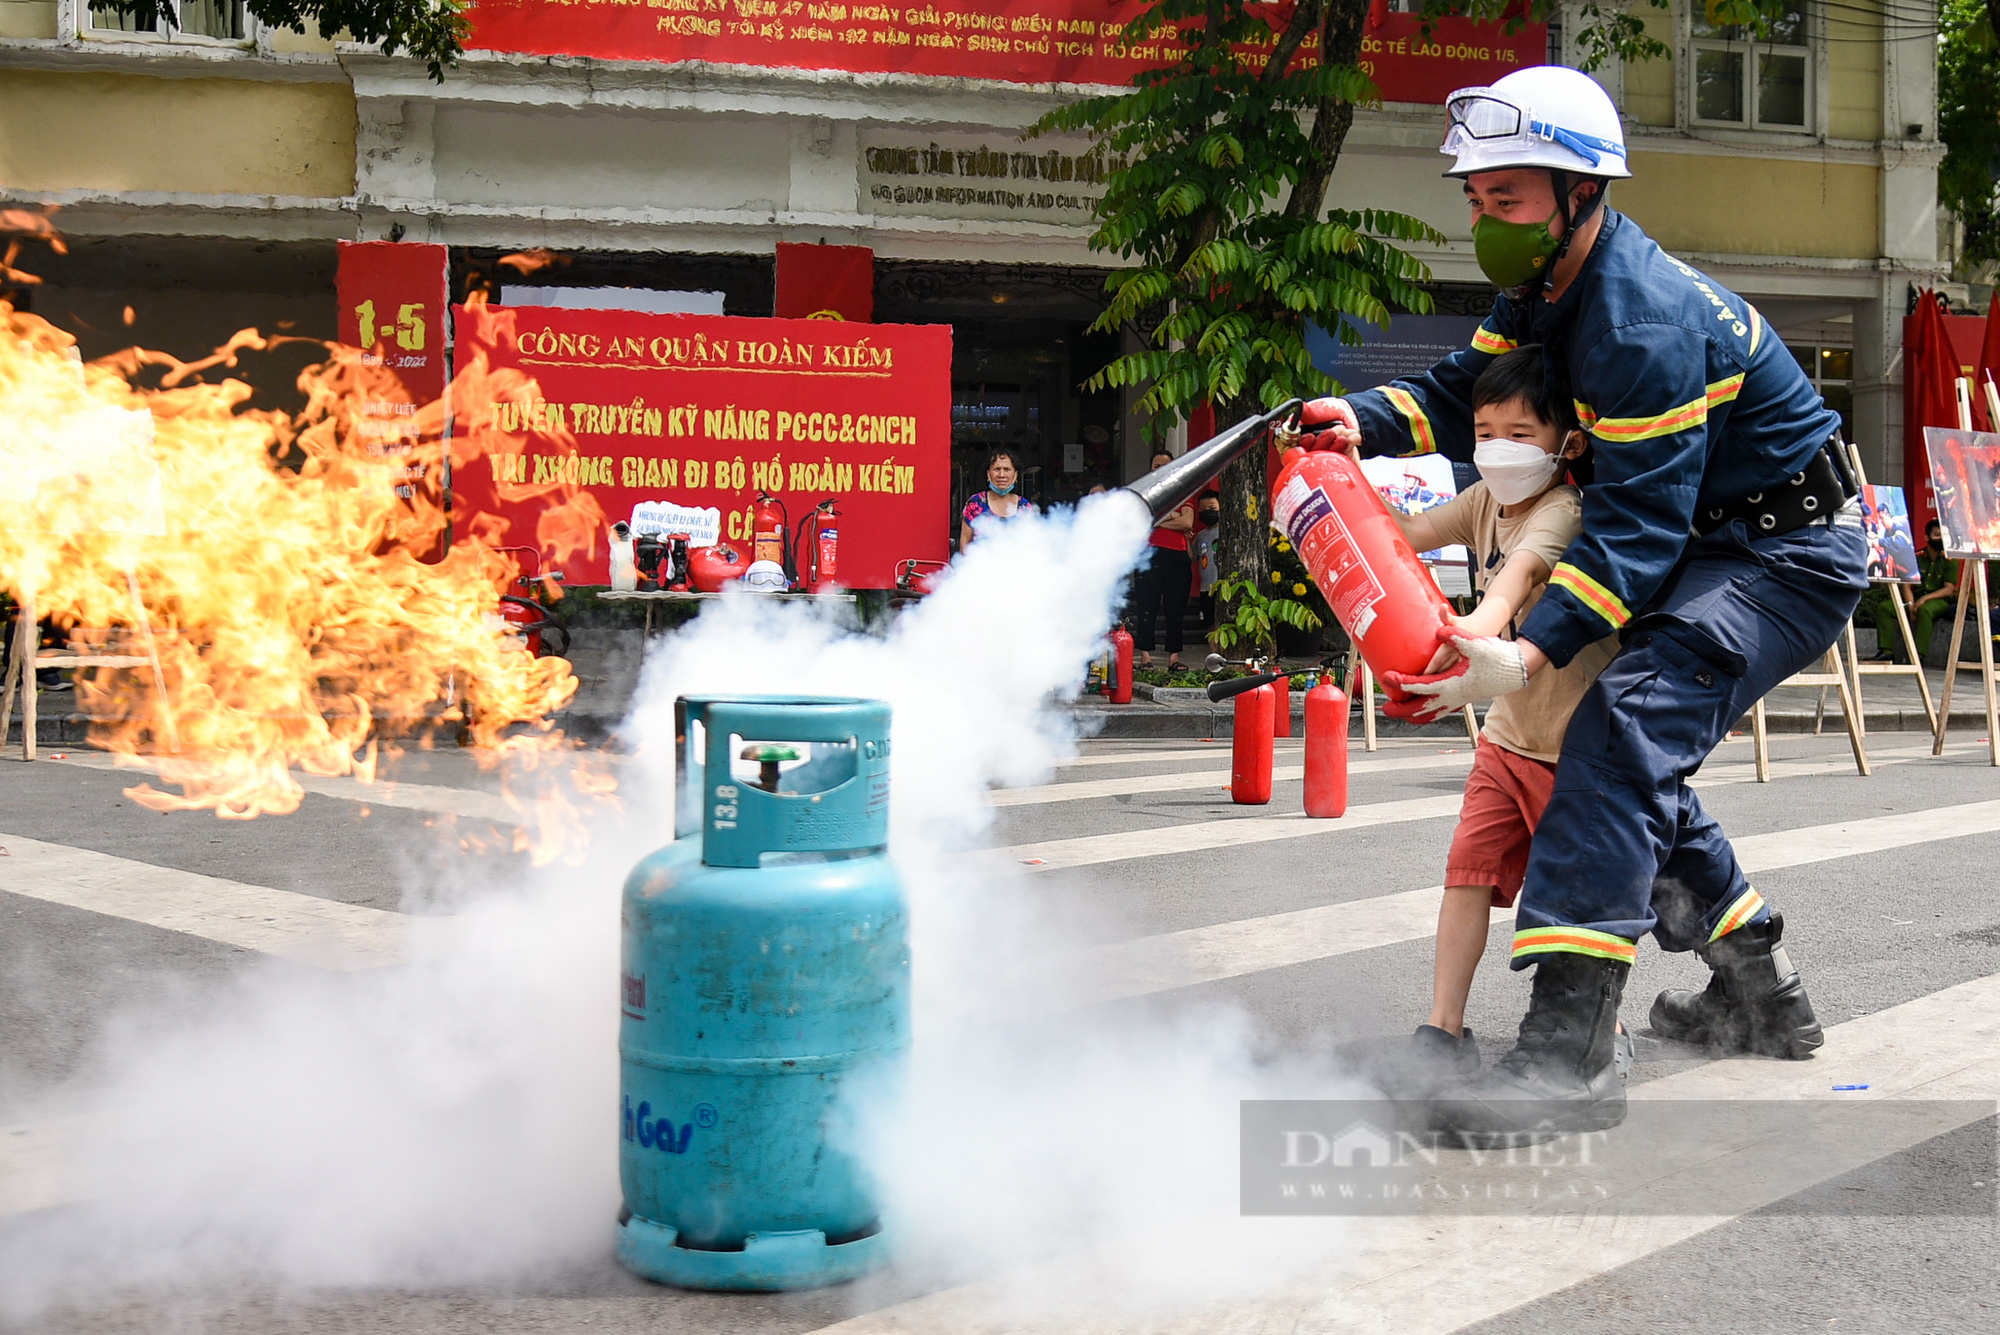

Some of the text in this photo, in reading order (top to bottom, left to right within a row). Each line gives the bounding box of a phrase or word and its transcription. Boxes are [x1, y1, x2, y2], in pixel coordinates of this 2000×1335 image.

[1057, 18, 1096, 36] NAM
[1386, 37, 1407, 55] TẾ
[1445, 42, 1490, 63] ĐỘNG
[1026, 191, 1054, 209] AND
[354, 299, 426, 351] 1-5
[517, 326, 600, 357] CÔNG
[606, 335, 646, 358] AN
[736, 337, 814, 365] HOÀN
[821, 336, 894, 369] KIẾM
[569, 396, 663, 437] TRUYỀN
[667, 402, 699, 437] KỸ
[704, 403, 770, 441] NĂNG
[775, 410, 917, 446] PCCC&CNCH
[621, 456, 679, 488] GIAN
[683, 459, 709, 489] ĐI
[714, 455, 747, 497] BỘ
[752, 452, 784, 492] HỒ
[788, 456, 853, 493] HOÀN
[858, 456, 915, 494] KIẾM
[714, 785, 739, 830] 13.8
